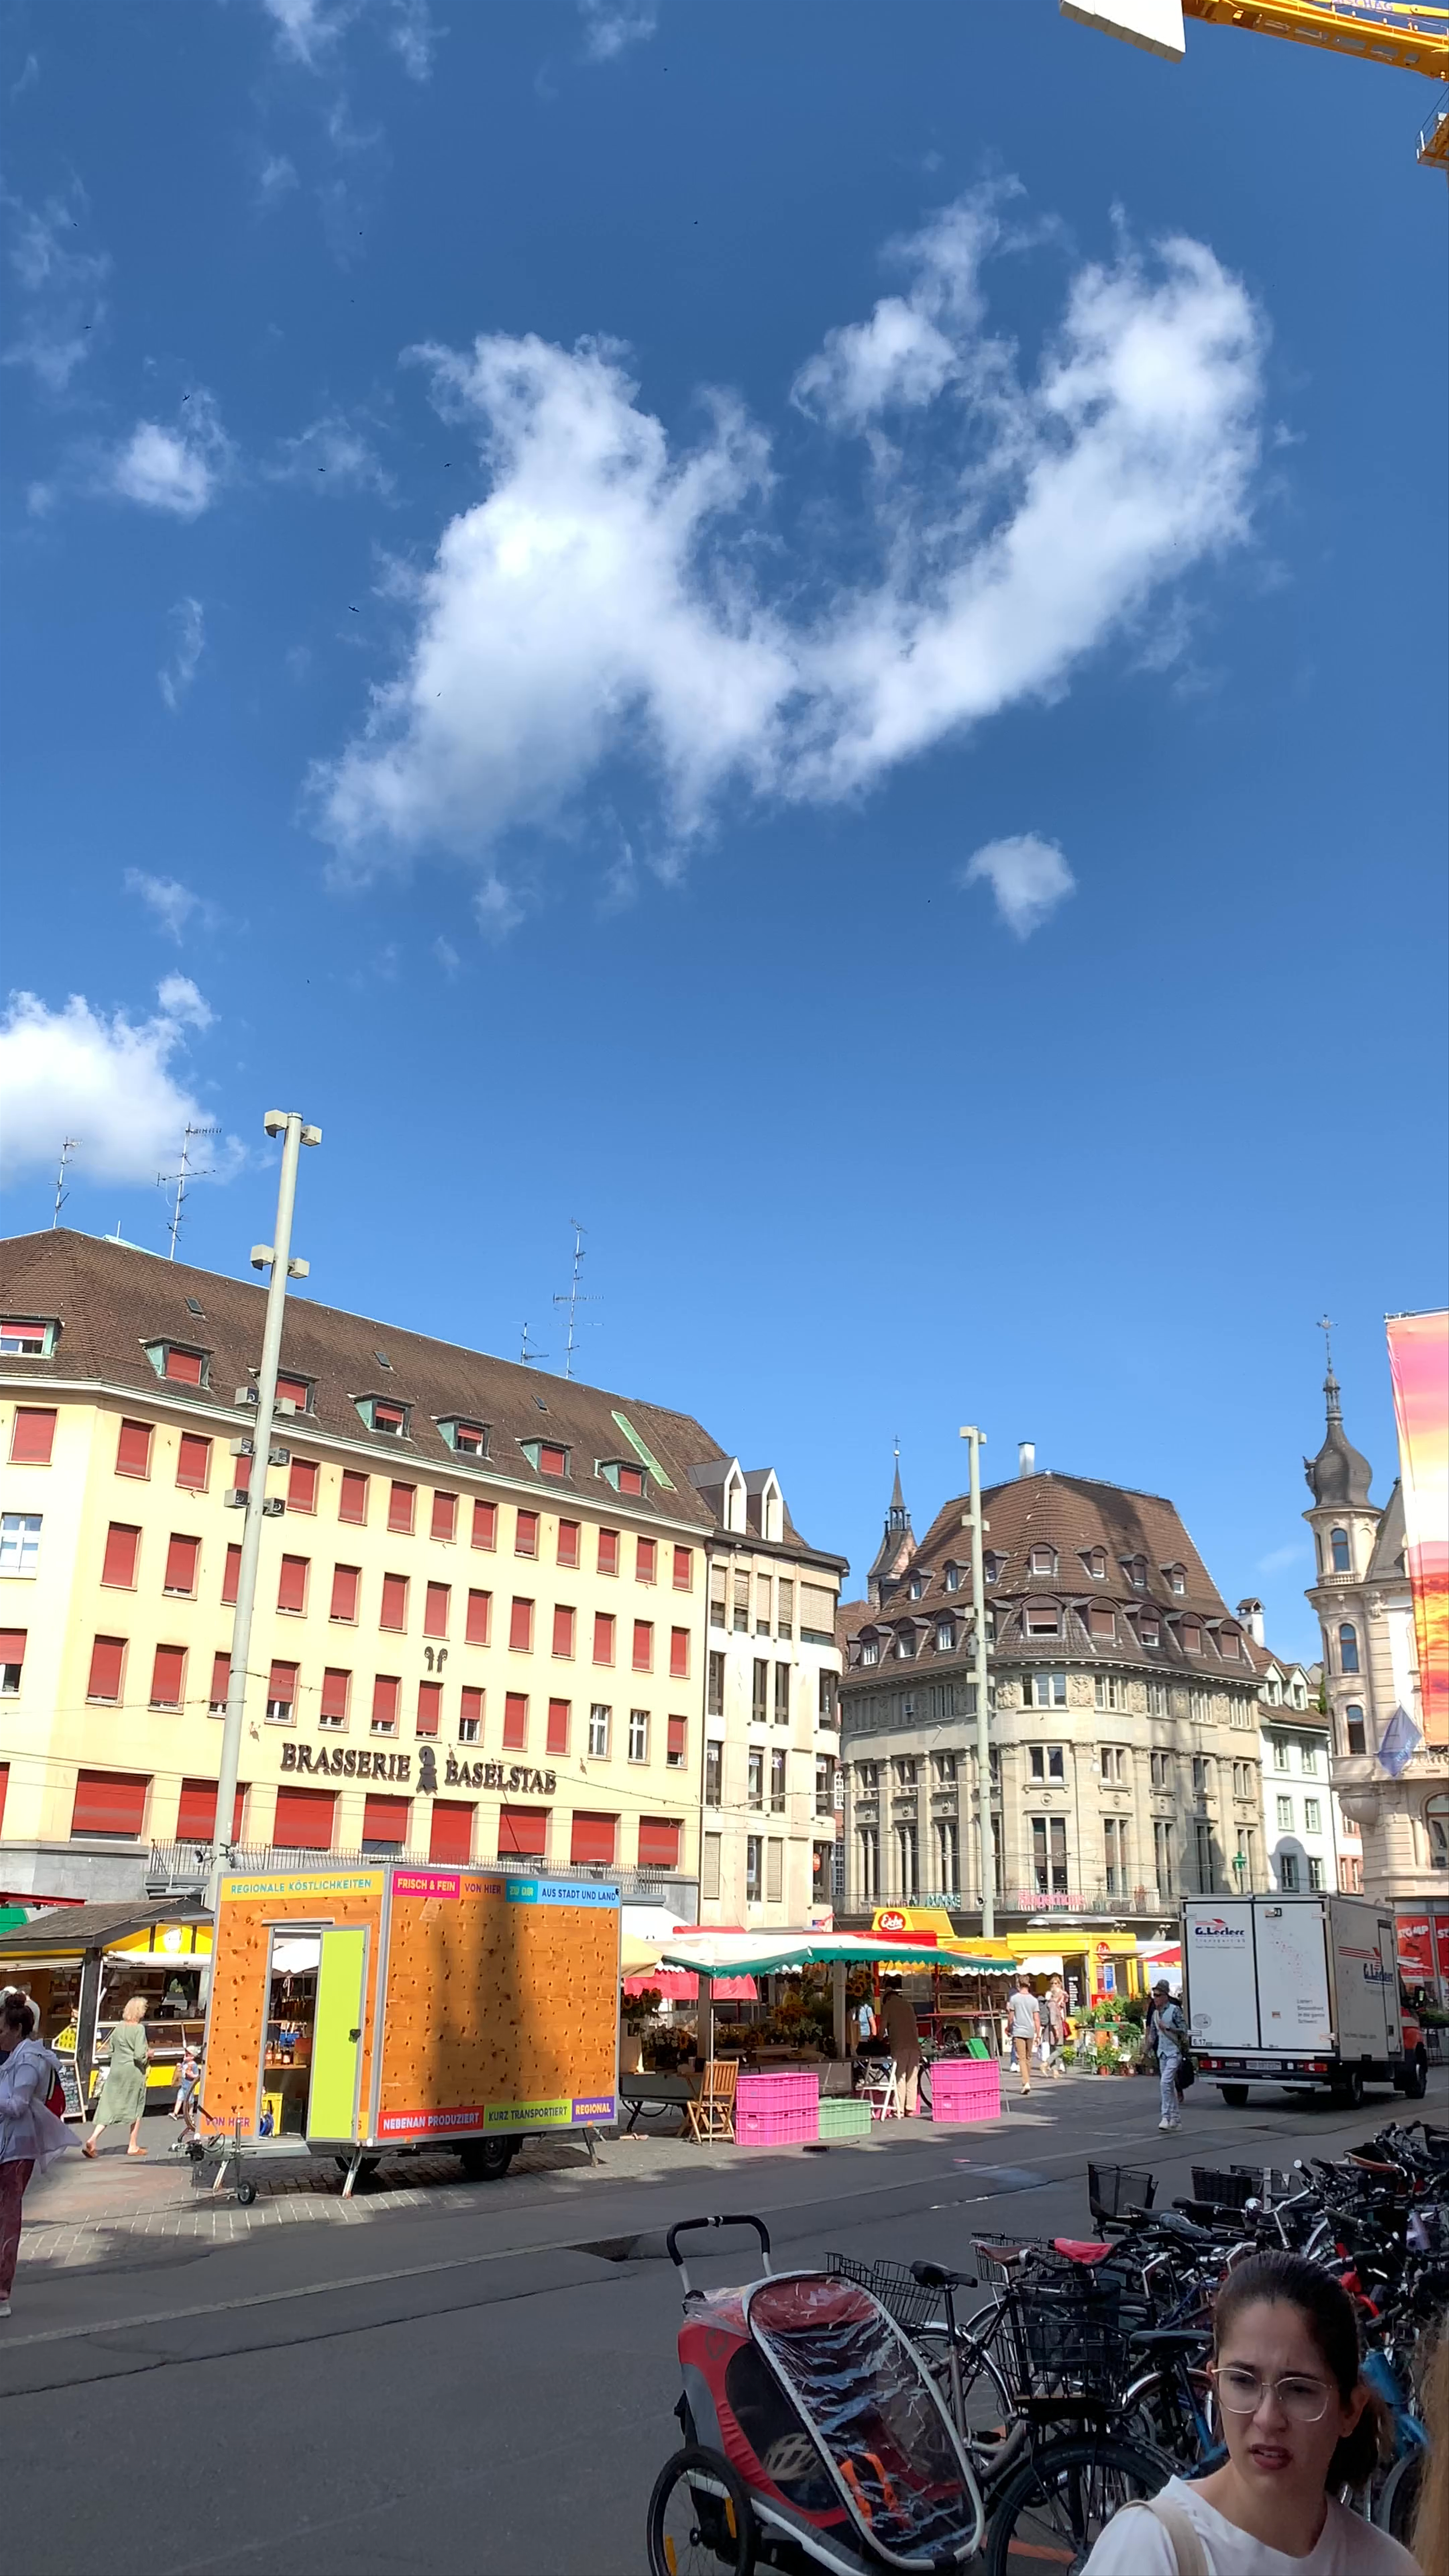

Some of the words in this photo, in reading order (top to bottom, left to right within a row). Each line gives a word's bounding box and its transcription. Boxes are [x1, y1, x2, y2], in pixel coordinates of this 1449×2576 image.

[280, 1742, 411, 1780] BRASSERIE
[445, 1759, 557, 1793] BASELSTAB
[231, 1883, 285, 1893] REGIONALE
[288, 1879, 371, 1892] KÖSTLICHKEITEN
[397, 1878, 427, 1890] FRISCH
[429, 1881, 435, 1890] &
[437, 1881, 456, 1892] FEIN
[465, 1883, 481, 1893] VON
[484, 1884, 501, 1895] HIER
[542, 1888, 556, 1897] AUS
[558, 1889, 580, 1898] STADT
[581, 1891, 596, 1900] UND
[598, 1892, 615, 1901] LAND
[488, 2110, 508, 2121] KURZ
[511, 2106, 567, 2121] TRANSPORTIERT
[575, 2103, 611, 2115] REGIONAL
[228, 2117, 250, 2127] HER
[383, 2116, 425, 2130] NEBENAN
[428, 2112, 479, 2127] PRODUZIERT
